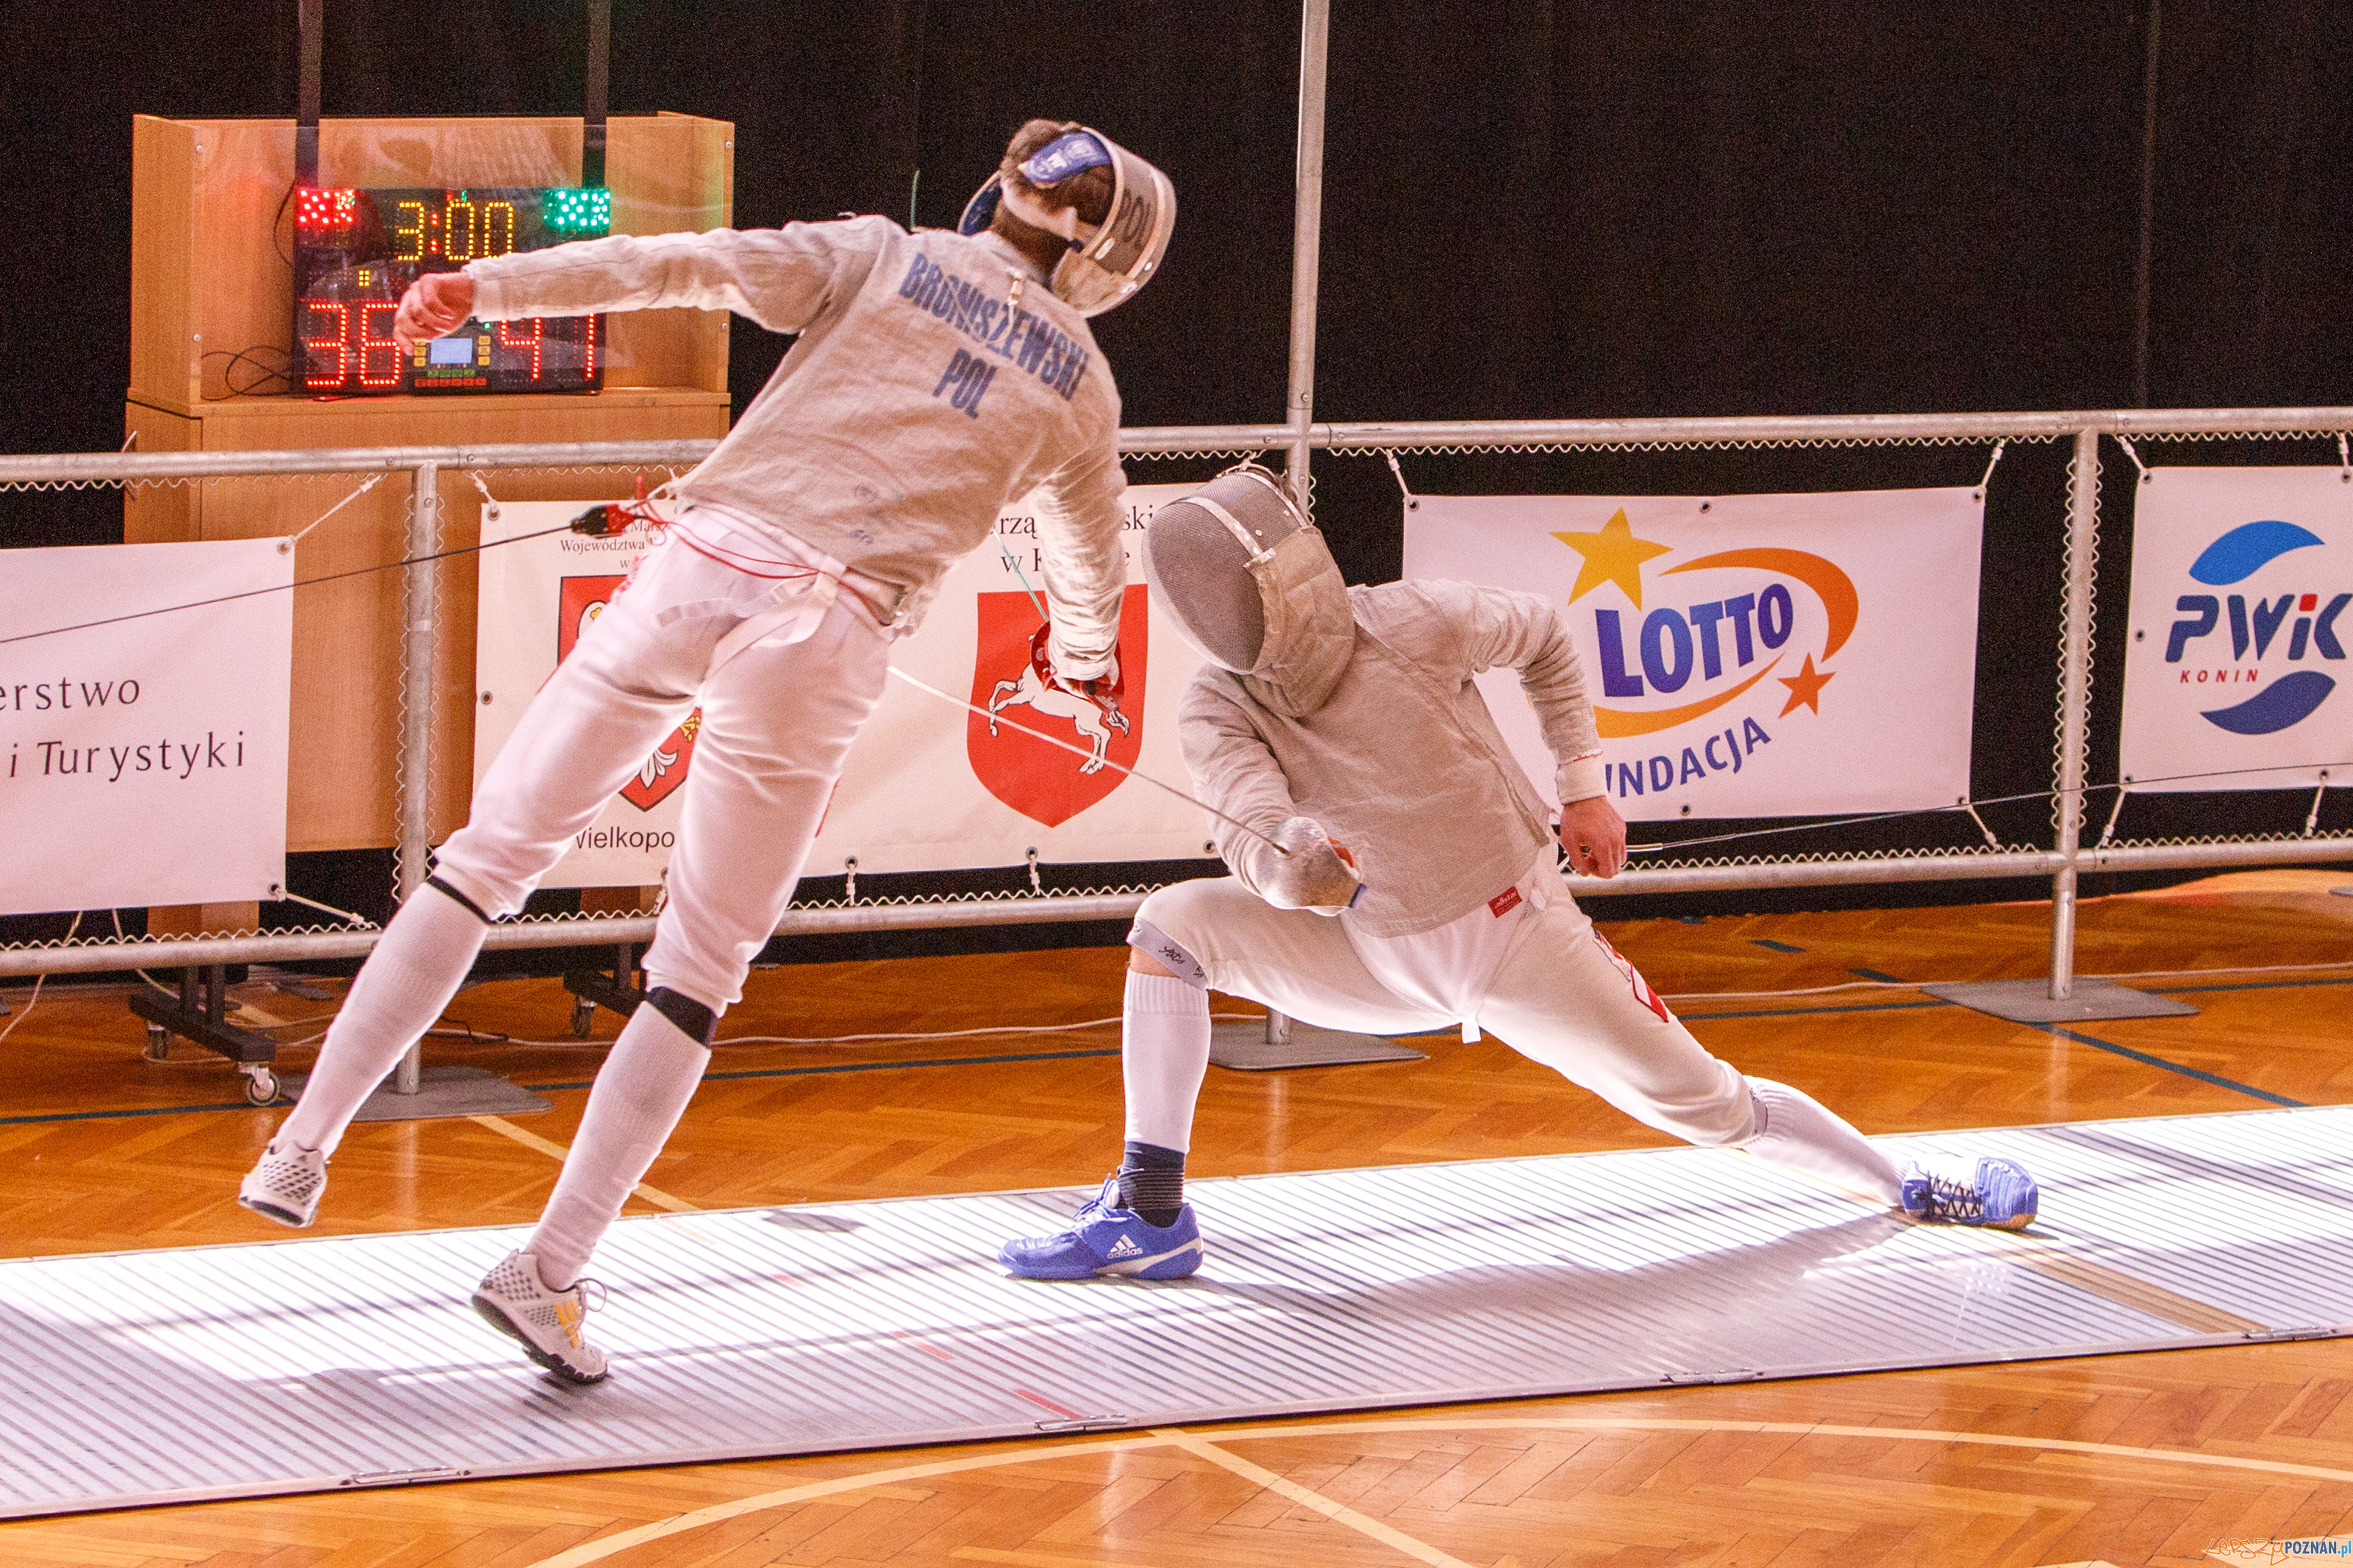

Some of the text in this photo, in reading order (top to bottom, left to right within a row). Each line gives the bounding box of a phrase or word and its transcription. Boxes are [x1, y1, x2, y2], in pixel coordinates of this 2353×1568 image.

[395, 201, 514, 261] 3:00
[307, 301, 401, 387] 36
[899, 251, 1090, 402] BRONISZEWSKI
[932, 347, 998, 420] POL
[560, 538, 645, 555] Województwa
[989, 516, 1038, 539] rzą
[1595, 584, 1793, 698] LOTTO
[2179, 669, 2259, 684] KONIN
[10, 731, 244, 782] i Turystyki
[1605, 716, 1771, 798] NDACJA
[576, 826, 675, 853] ielkopo
[1107, 1246, 1143, 1259] adidas
